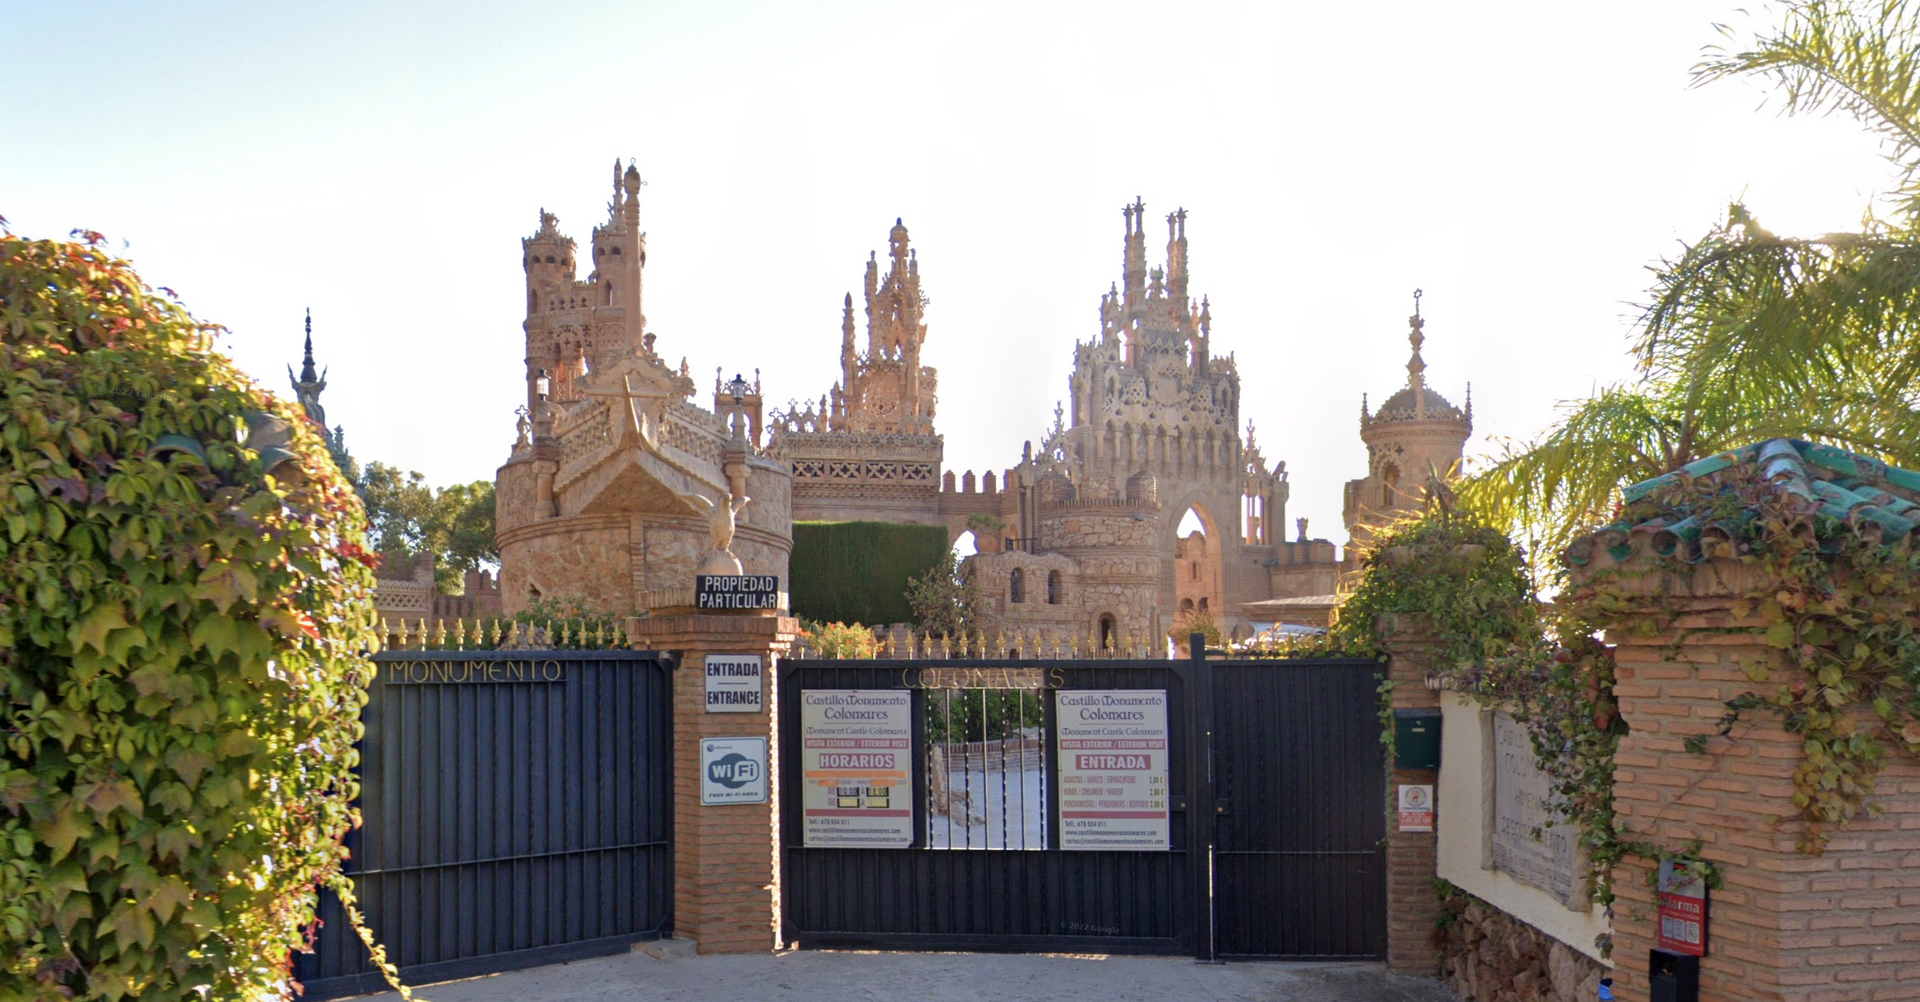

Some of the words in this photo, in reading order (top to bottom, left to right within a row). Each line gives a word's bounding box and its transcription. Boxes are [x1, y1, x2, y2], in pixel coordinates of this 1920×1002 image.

[705, 577, 773, 592] PROPIEDAD
[699, 593, 777, 609] PARTICULAR
[390, 660, 561, 683] MONUMENTO
[707, 663, 759, 676] ENTRADA
[707, 691, 760, 705] ENTRANCE
[805, 695, 845, 706] Castillo
[846, 695, 907, 706] Monumento
[1060, 695, 1100, 706] Castillo
[1101, 695, 1162, 706] Monumento
[824, 707, 888, 720] Colomares
[1080, 707, 1145, 720] Colomares
[806, 727, 845, 735] Monument
[845, 727, 869, 735] Castle
[869, 727, 907, 735] Colomares
[1061, 727, 1101, 735] Monument
[806, 739, 825, 748] VISITA
[827, 739, 856, 748] EXTERIOR
[861, 739, 891, 748] EXTERIOR
[892, 739, 907, 748] VISIT
[1062, 740, 1081, 749] VISITA
[1083, 740, 1112, 749] EXTERIOR
[1118, 740, 1147, 749] EXTERIOR
[1148, 740, 1164, 749] VISIT
[820, 755, 894, 768] HORARIOS
[1080, 756, 1146, 769] ENTRADA
[828, 787, 836, 795] DE
[839, 787, 857, 795] 10:00
[869, 787, 886, 795] 18:00
[828, 798, 836, 806] DE
